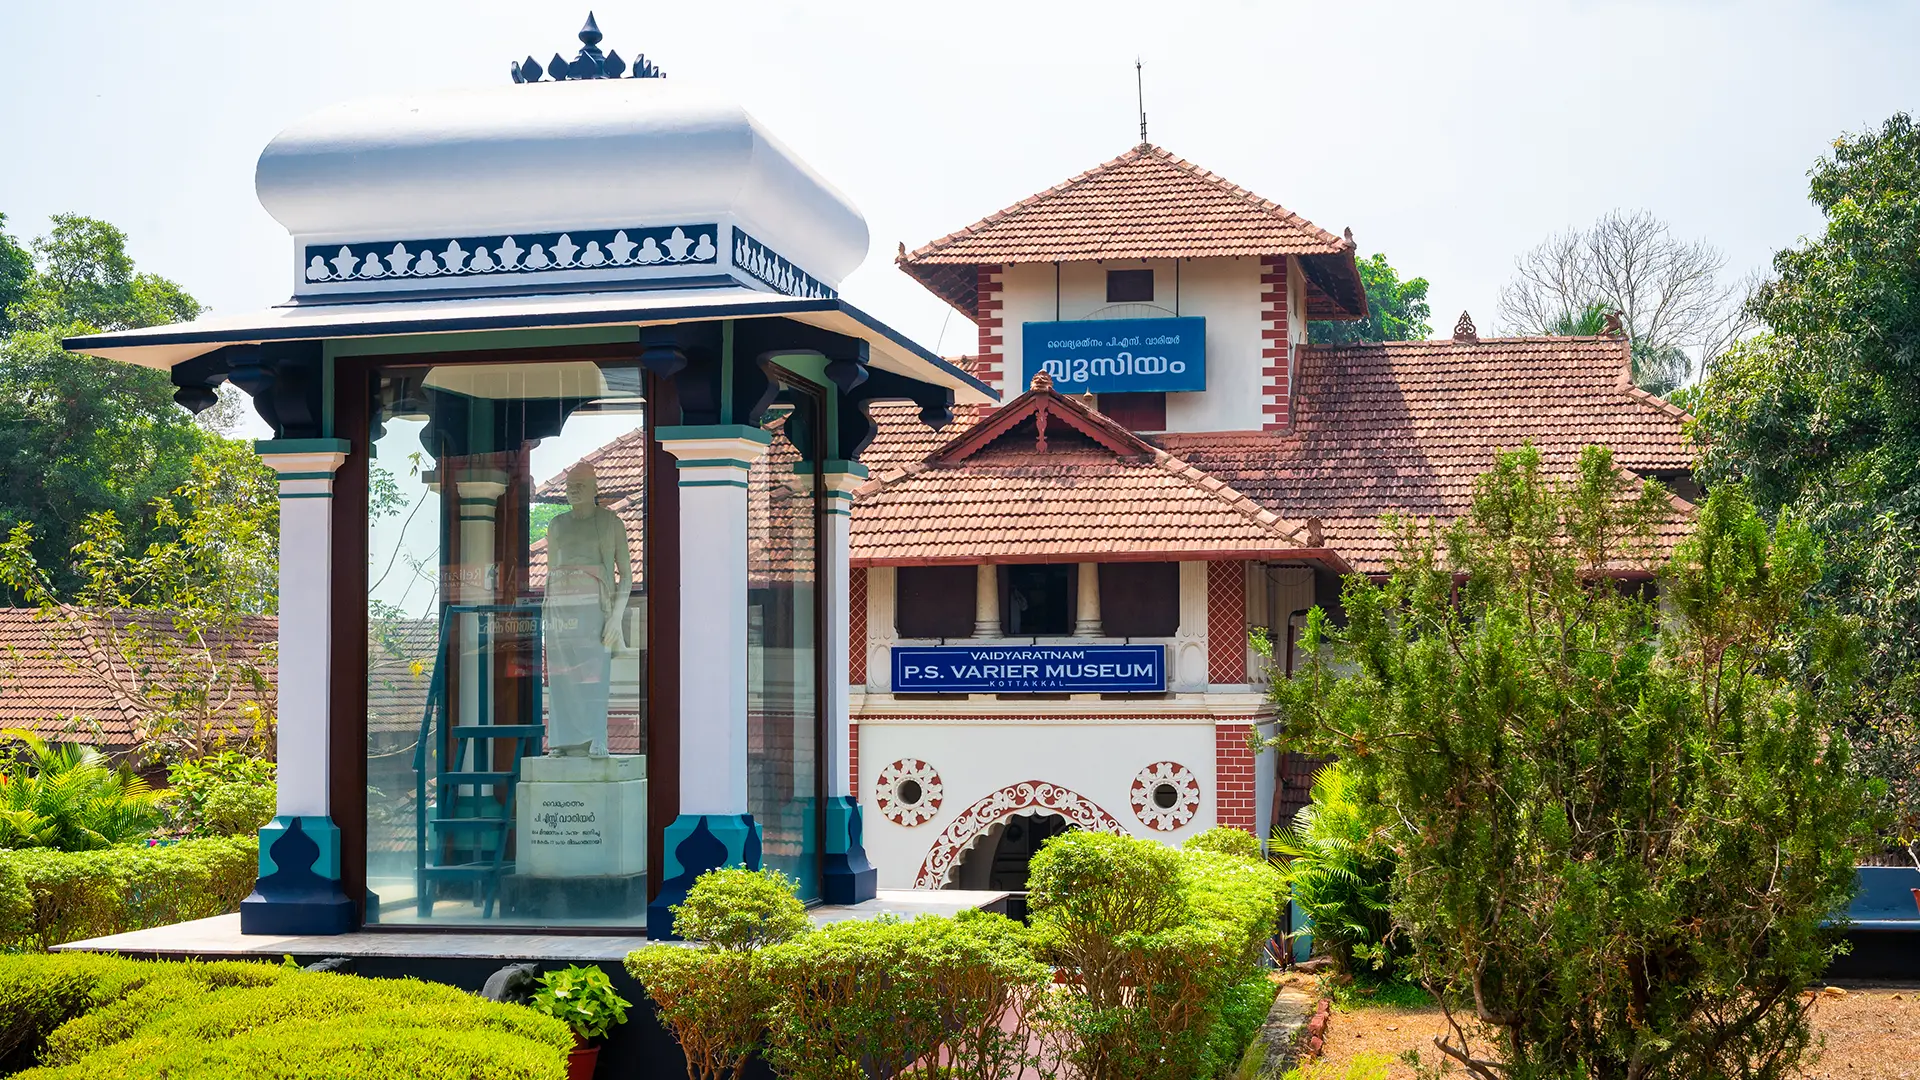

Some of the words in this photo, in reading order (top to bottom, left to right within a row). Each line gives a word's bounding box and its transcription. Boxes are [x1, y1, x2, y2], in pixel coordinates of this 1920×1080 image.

[1041, 352, 1186, 383] മ്യൂസിയം
[970, 651, 1085, 661] VAIDYARATNAM
[904, 665, 944, 679] P.S.
[951, 664, 1039, 679] VARIER
[1045, 663, 1153, 678] MUSEUM
